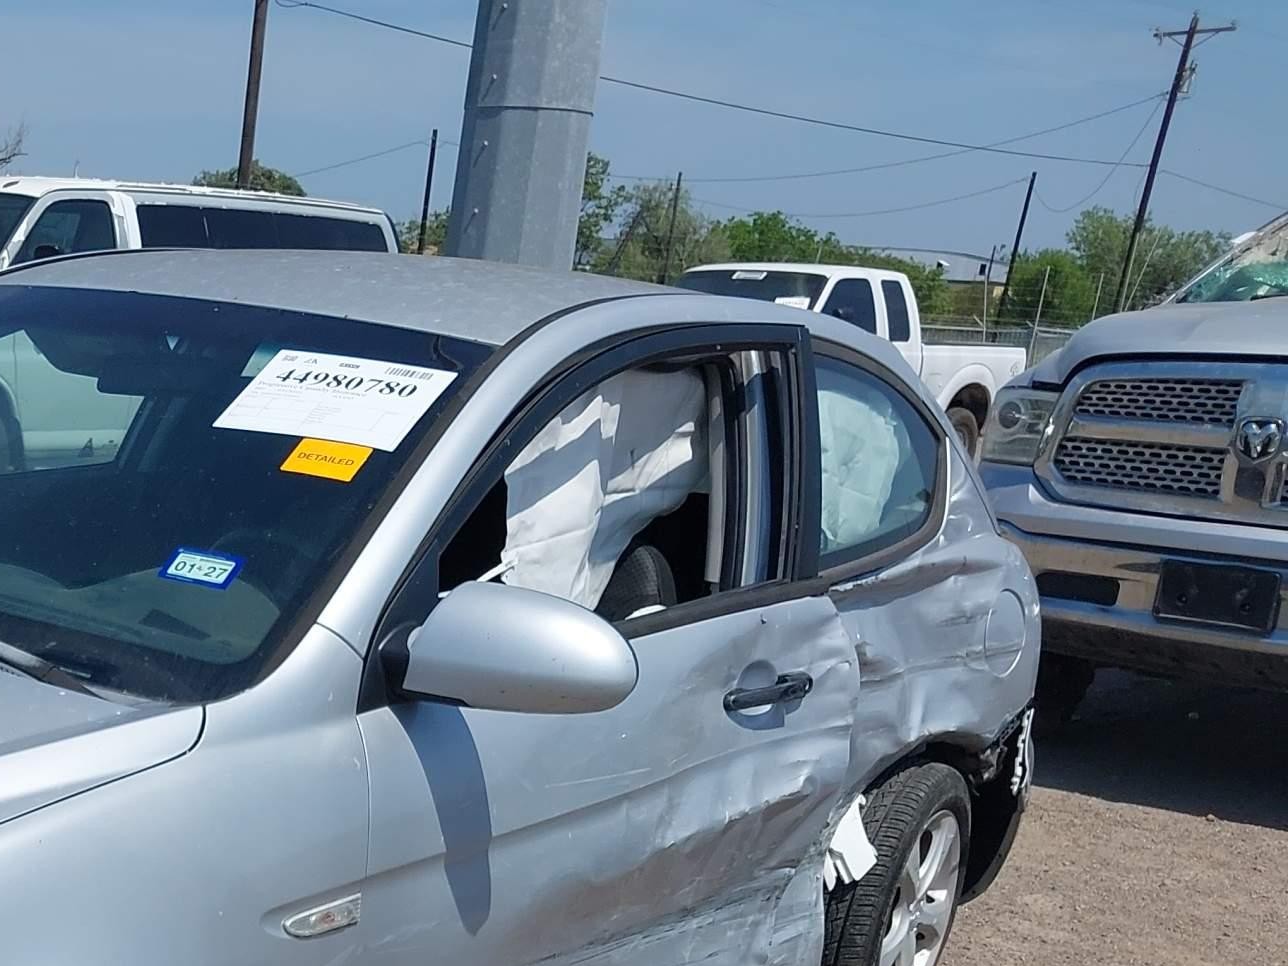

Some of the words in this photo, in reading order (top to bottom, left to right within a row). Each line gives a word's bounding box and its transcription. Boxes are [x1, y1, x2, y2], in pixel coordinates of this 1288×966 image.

[276, 368, 417, 398] 44980780
[297, 451, 355, 467] DETAILED
[174, 560, 196, 574] 01
[202, 566, 229, 579] 27
